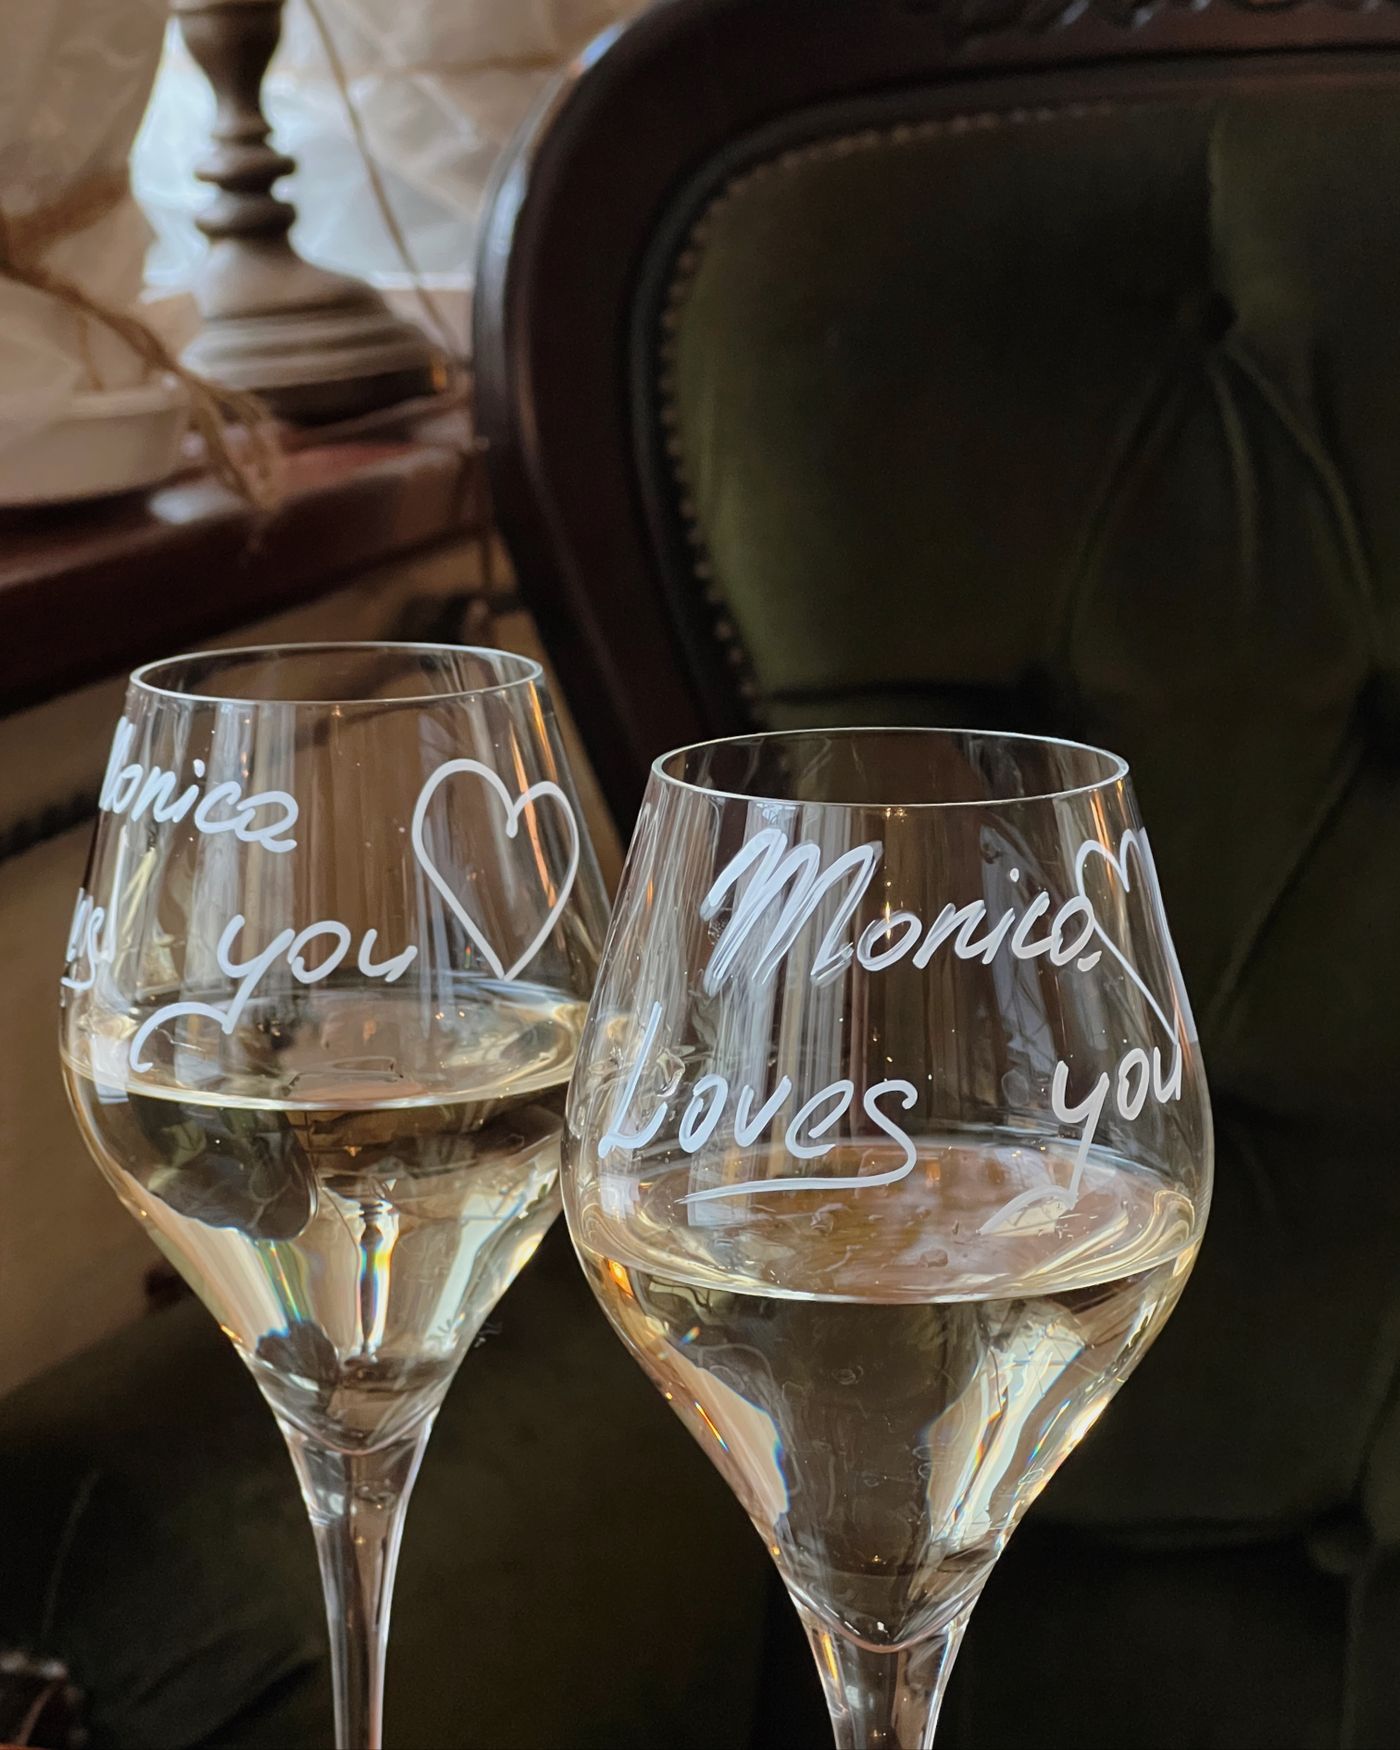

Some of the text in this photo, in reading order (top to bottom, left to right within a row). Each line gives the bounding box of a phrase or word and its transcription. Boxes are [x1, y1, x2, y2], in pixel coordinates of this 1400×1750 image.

[130, 914, 417, 1073] you
[701, 829, 1102, 997] Monica
[598, 1002, 1182, 1236] Loves you
